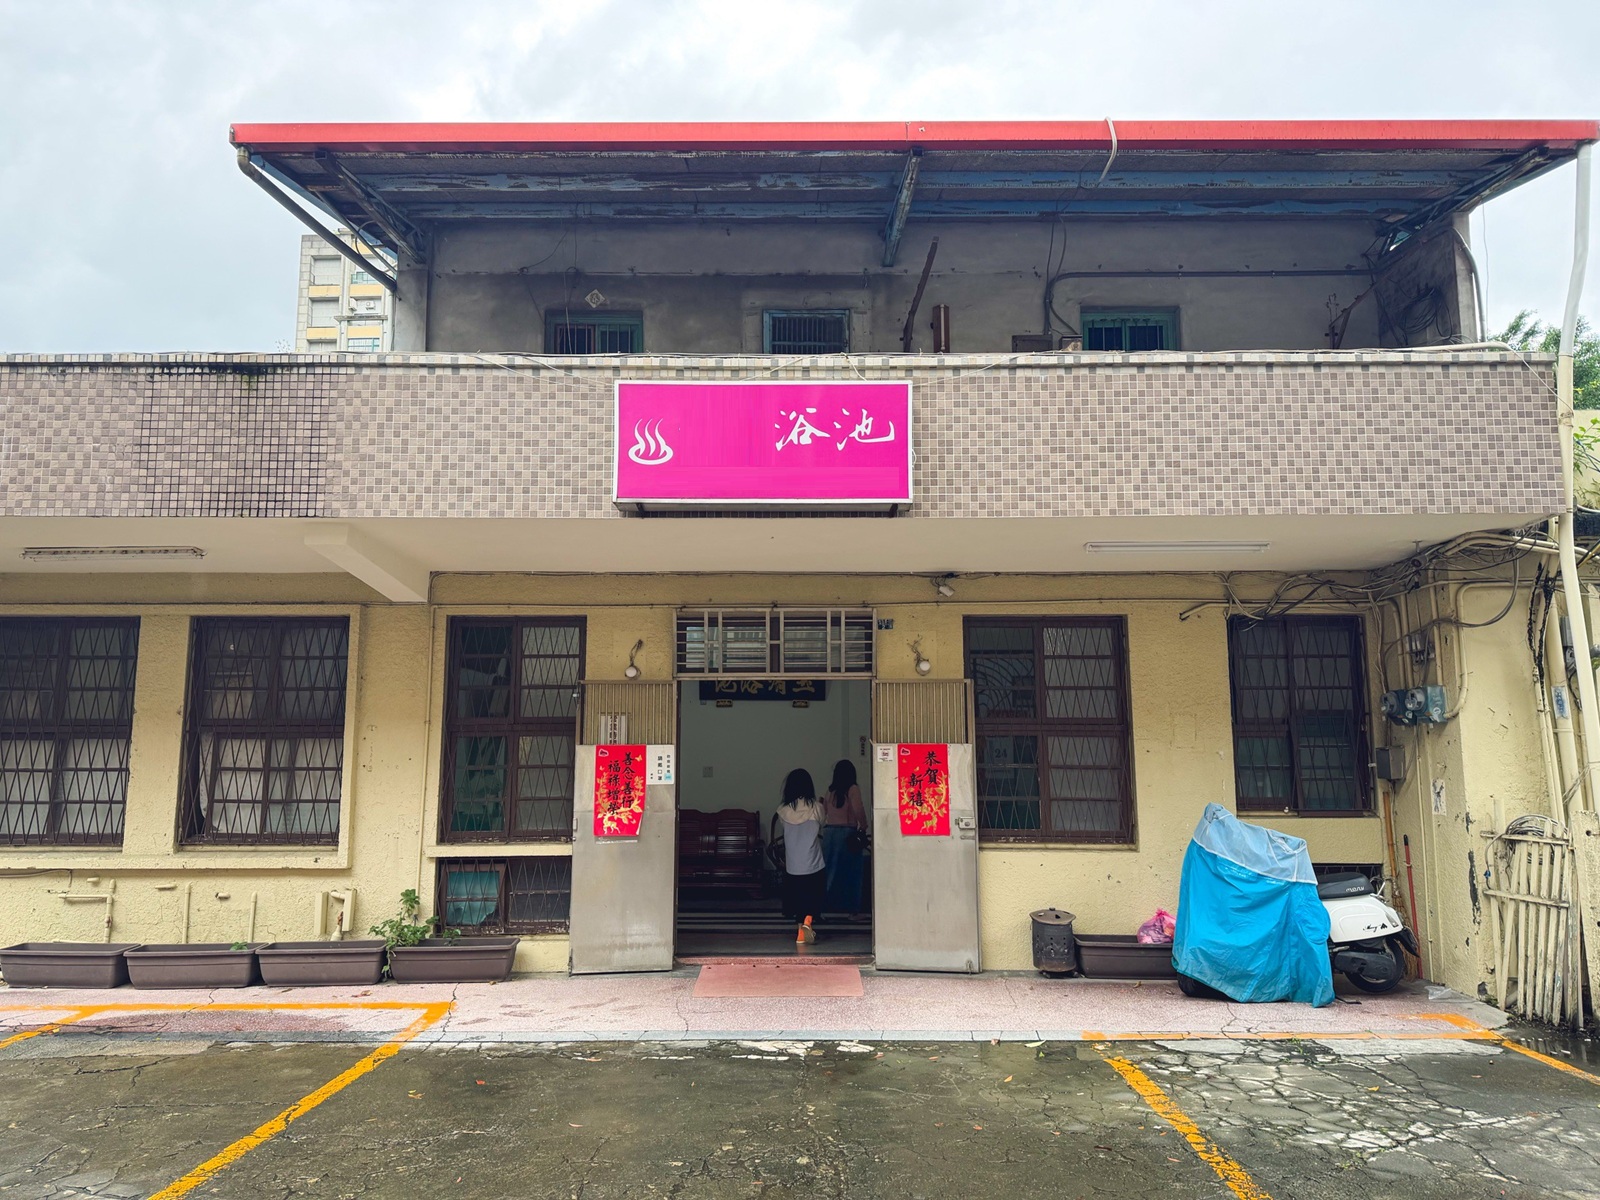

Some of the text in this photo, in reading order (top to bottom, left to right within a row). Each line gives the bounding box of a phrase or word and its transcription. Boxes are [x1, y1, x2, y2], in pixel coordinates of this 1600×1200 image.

[774, 407, 895, 451] 浴池
[622, 752, 635, 808] 善念善行
[923, 751, 941, 785] 恭賀
[908, 773, 925, 806] 新禧
